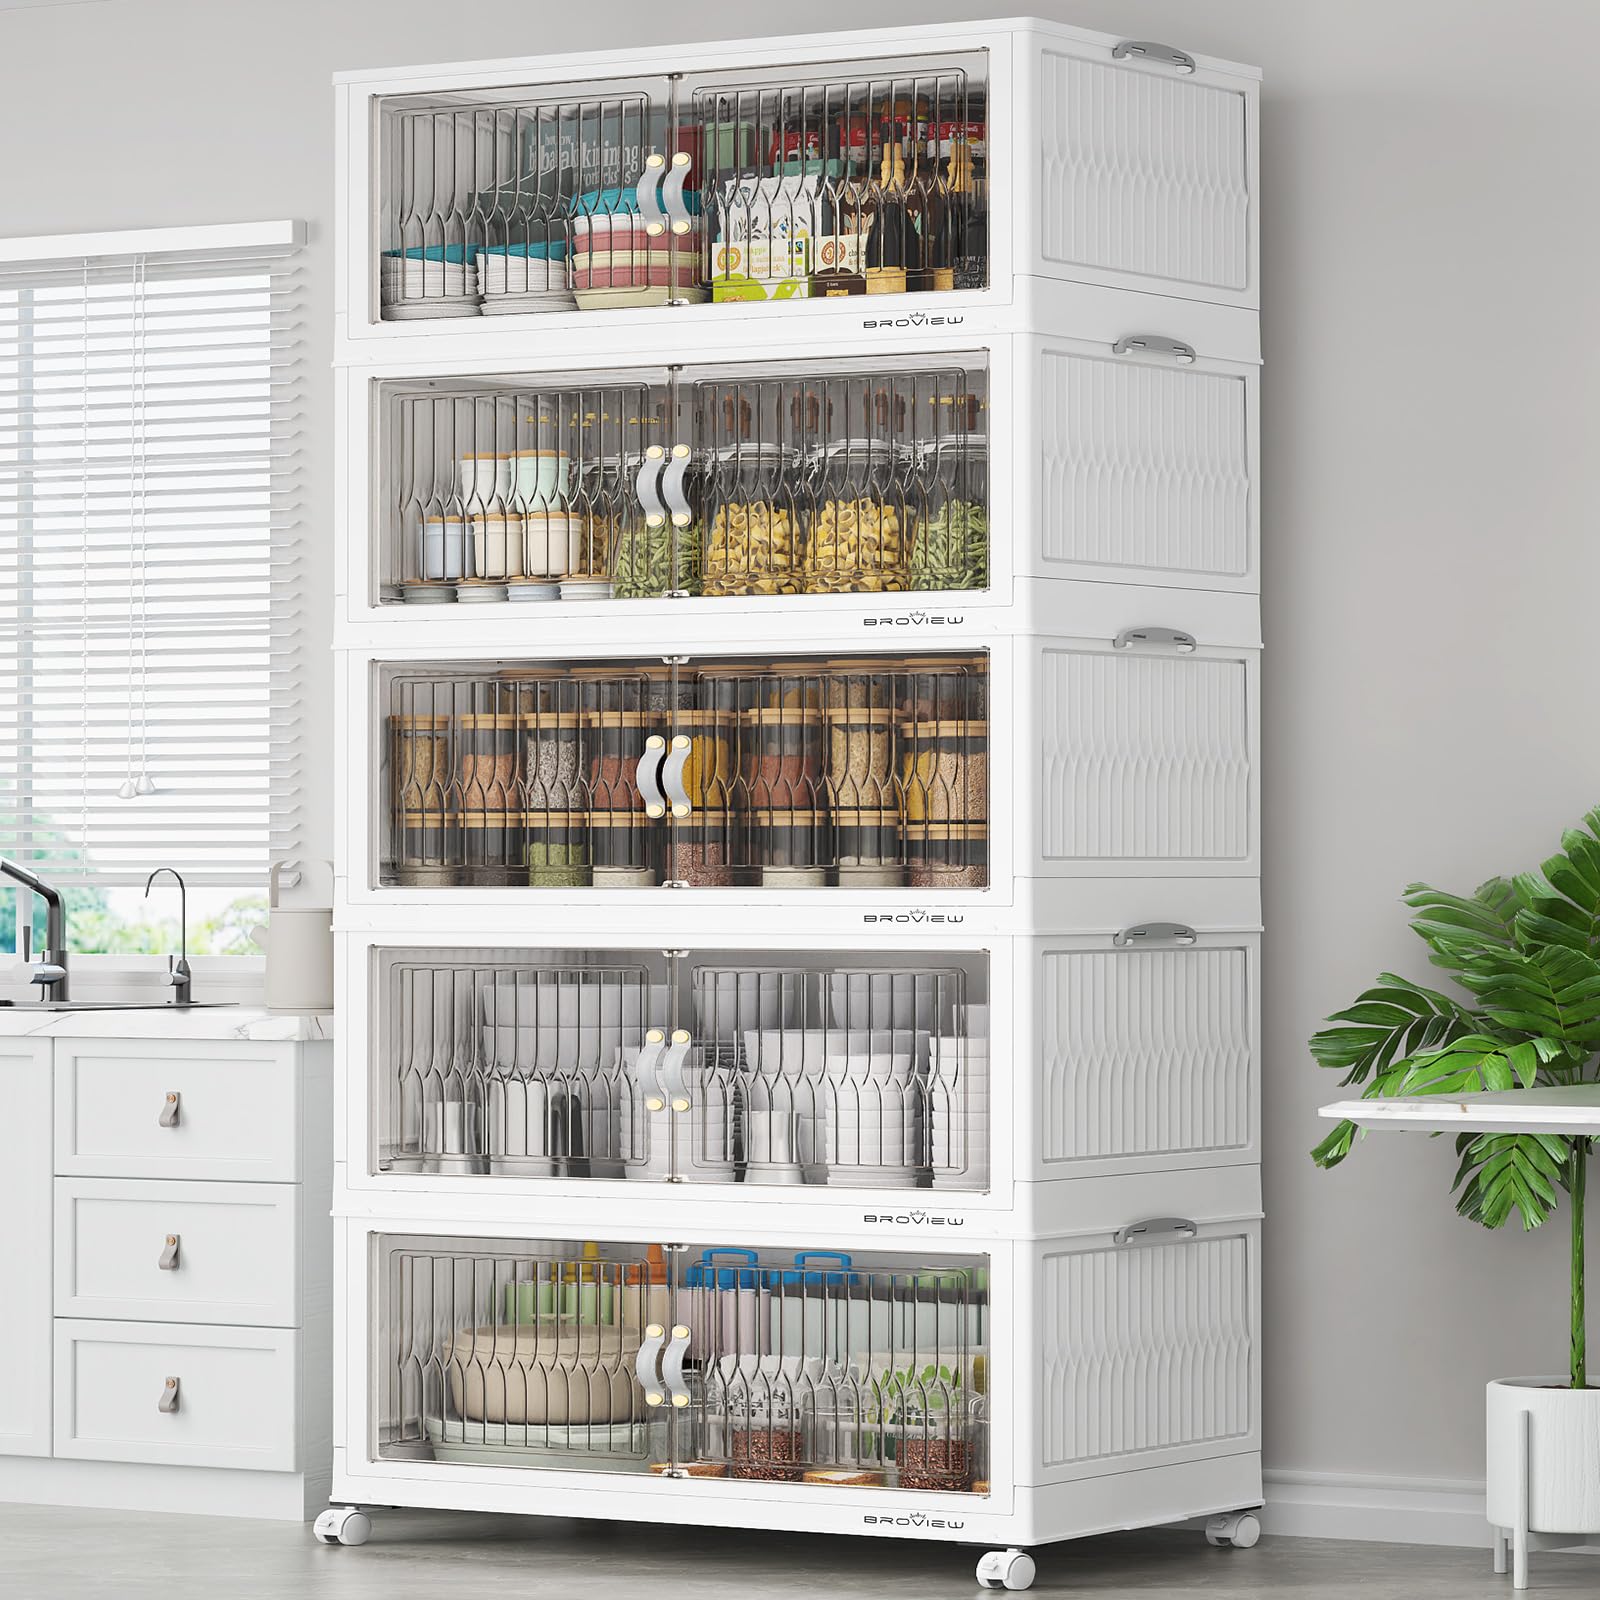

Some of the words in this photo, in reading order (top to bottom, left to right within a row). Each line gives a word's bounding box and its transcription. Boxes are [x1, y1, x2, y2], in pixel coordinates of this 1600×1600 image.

[863, 316, 964, 329] BROVIEW
[863, 615, 964, 626] BROVIEW
[863, 914, 964, 924] BROVIEW
[863, 1214, 964, 1226] BROVIEW
[863, 1515, 965, 1529] BROVIEW
